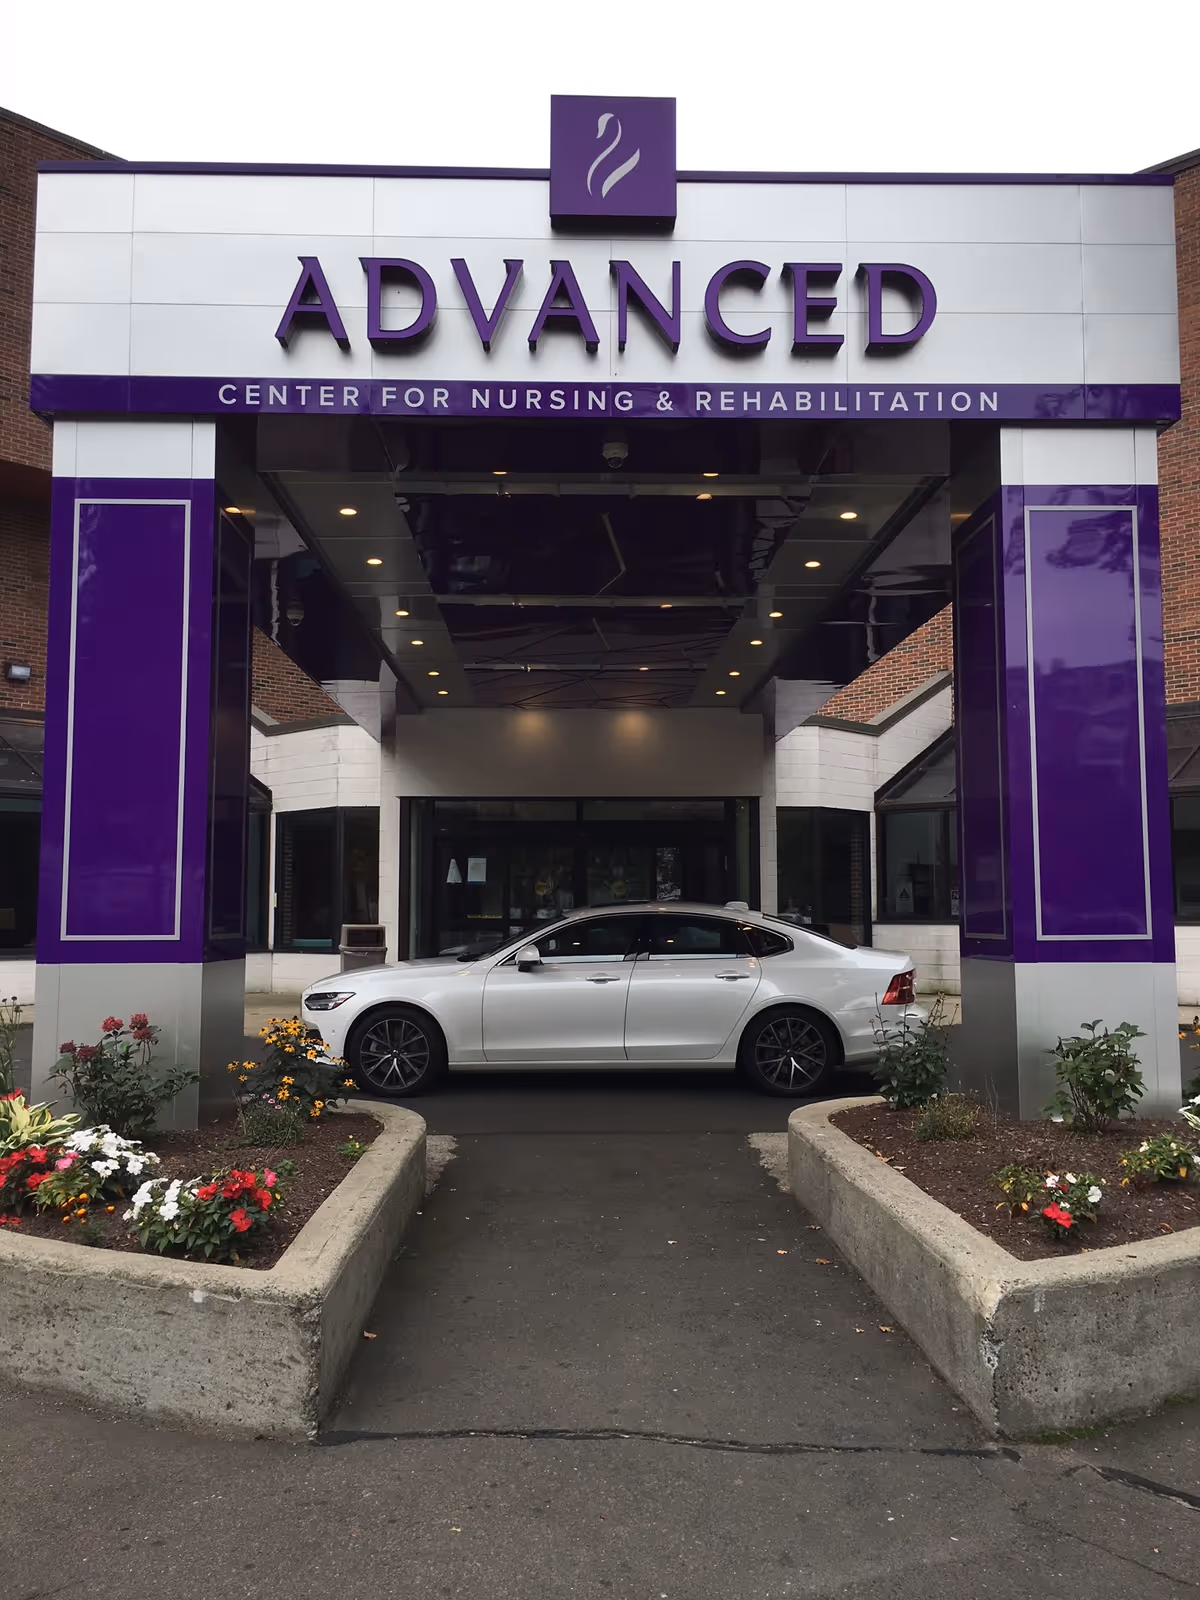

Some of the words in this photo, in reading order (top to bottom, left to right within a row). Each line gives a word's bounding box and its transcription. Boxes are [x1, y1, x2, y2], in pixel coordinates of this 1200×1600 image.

[275, 256, 938, 354] ADVANCED
[218, 384, 360, 407] CENTER
[381, 387, 450, 409] FOR
[471, 389, 634, 412] NURSING
[655, 391, 674, 412] &
[695, 391, 999, 413] REHABILITATION
